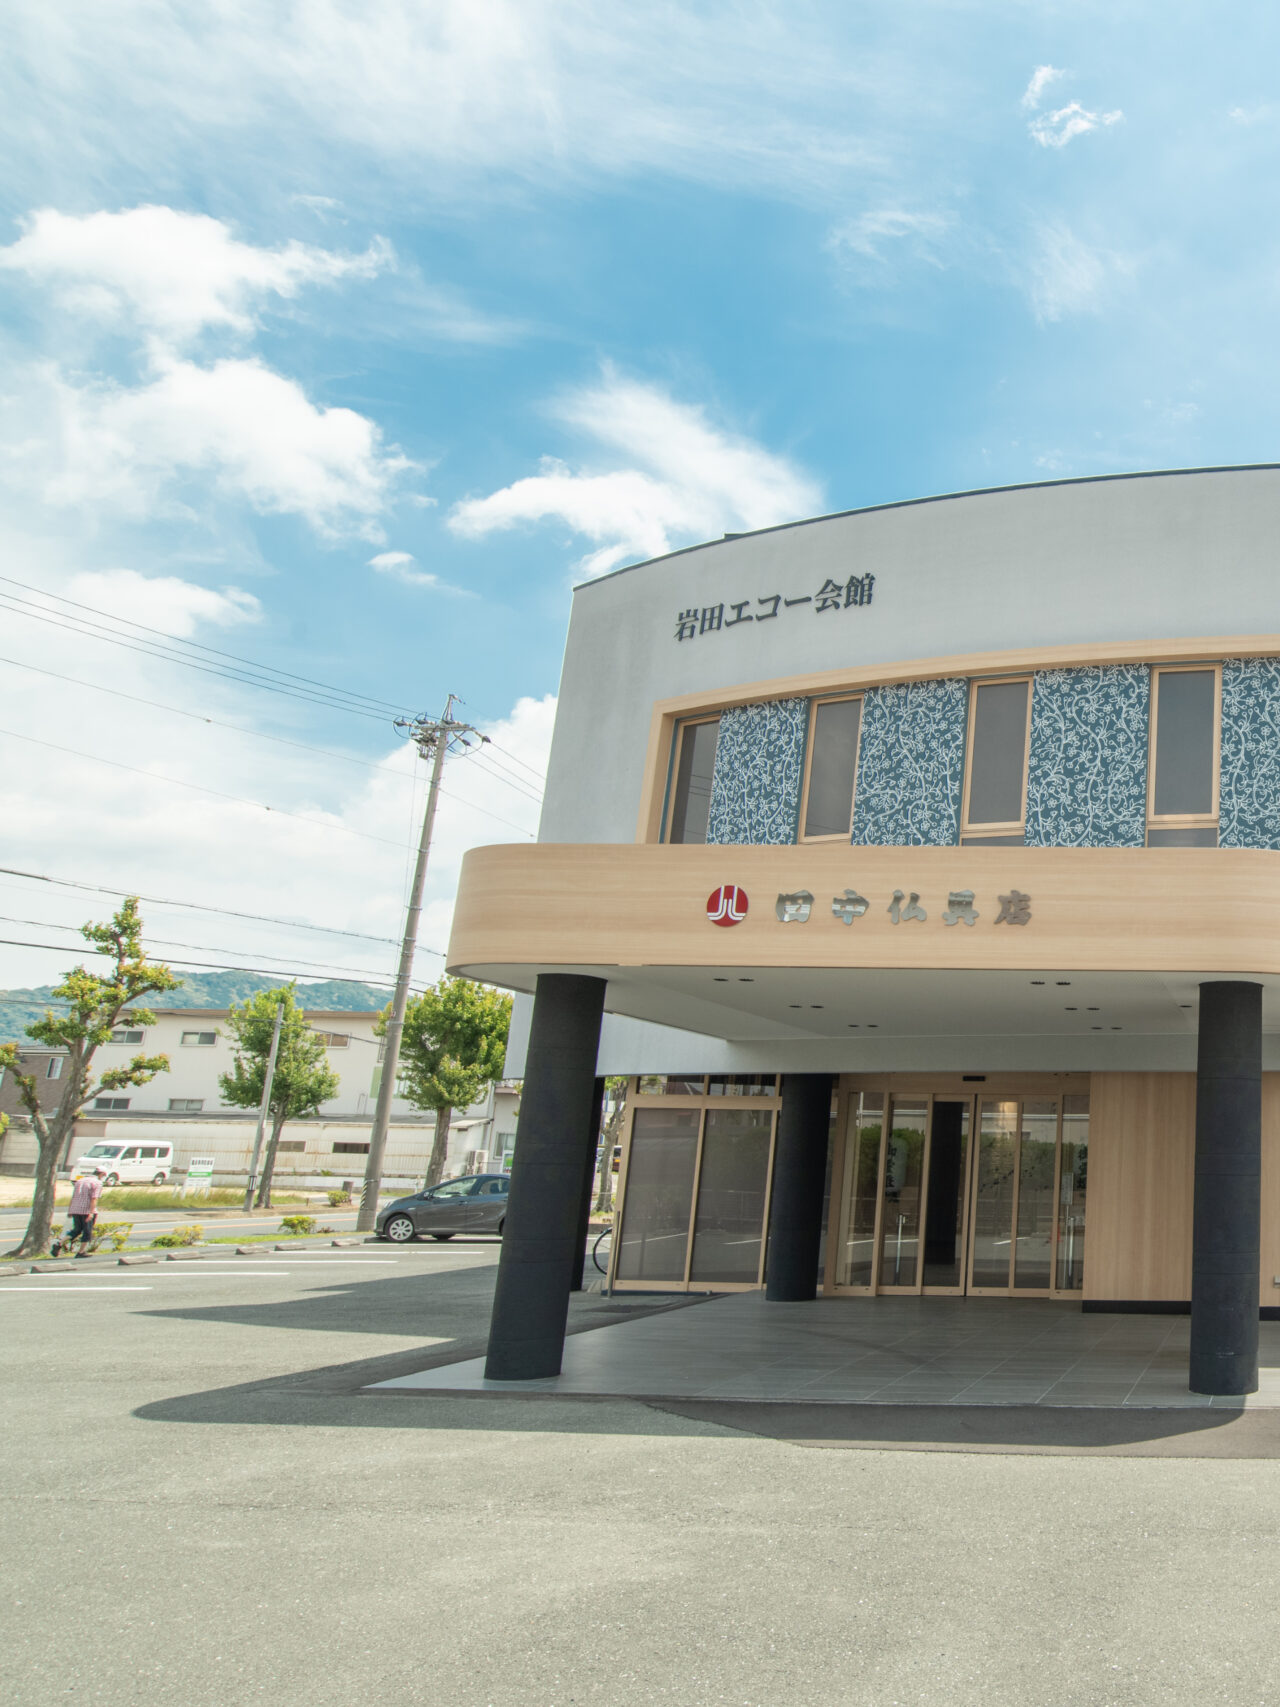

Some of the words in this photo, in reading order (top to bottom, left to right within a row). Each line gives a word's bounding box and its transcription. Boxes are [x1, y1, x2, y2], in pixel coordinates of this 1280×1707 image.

[673, 573, 876, 641] 岩田エコー会館
[775, 889, 1032, 926] 田中仏具店
